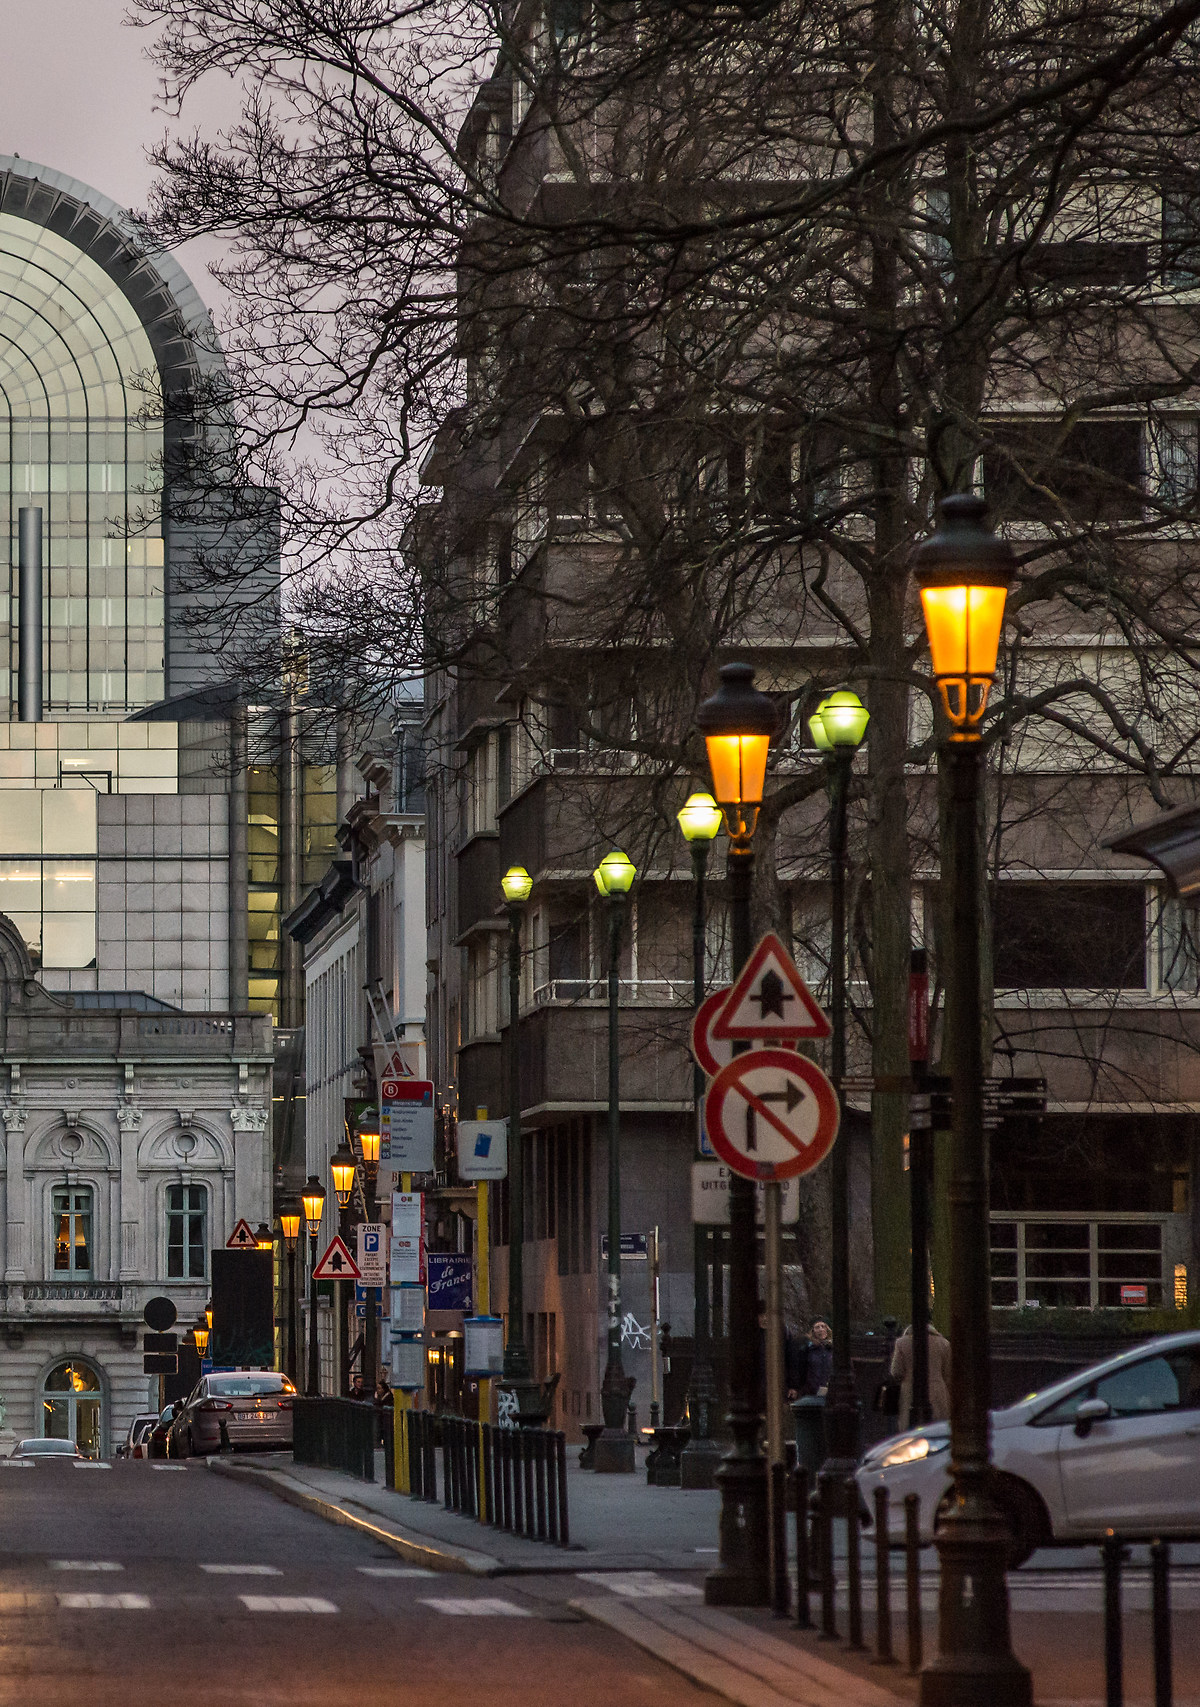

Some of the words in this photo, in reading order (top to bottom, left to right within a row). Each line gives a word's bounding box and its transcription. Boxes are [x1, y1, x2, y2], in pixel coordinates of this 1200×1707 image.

[388, 1086, 394, 1094] B
[366, 1235, 376, 1250] P
[441, 1266, 454, 1278] de
[430, 1272, 471, 1293] France
